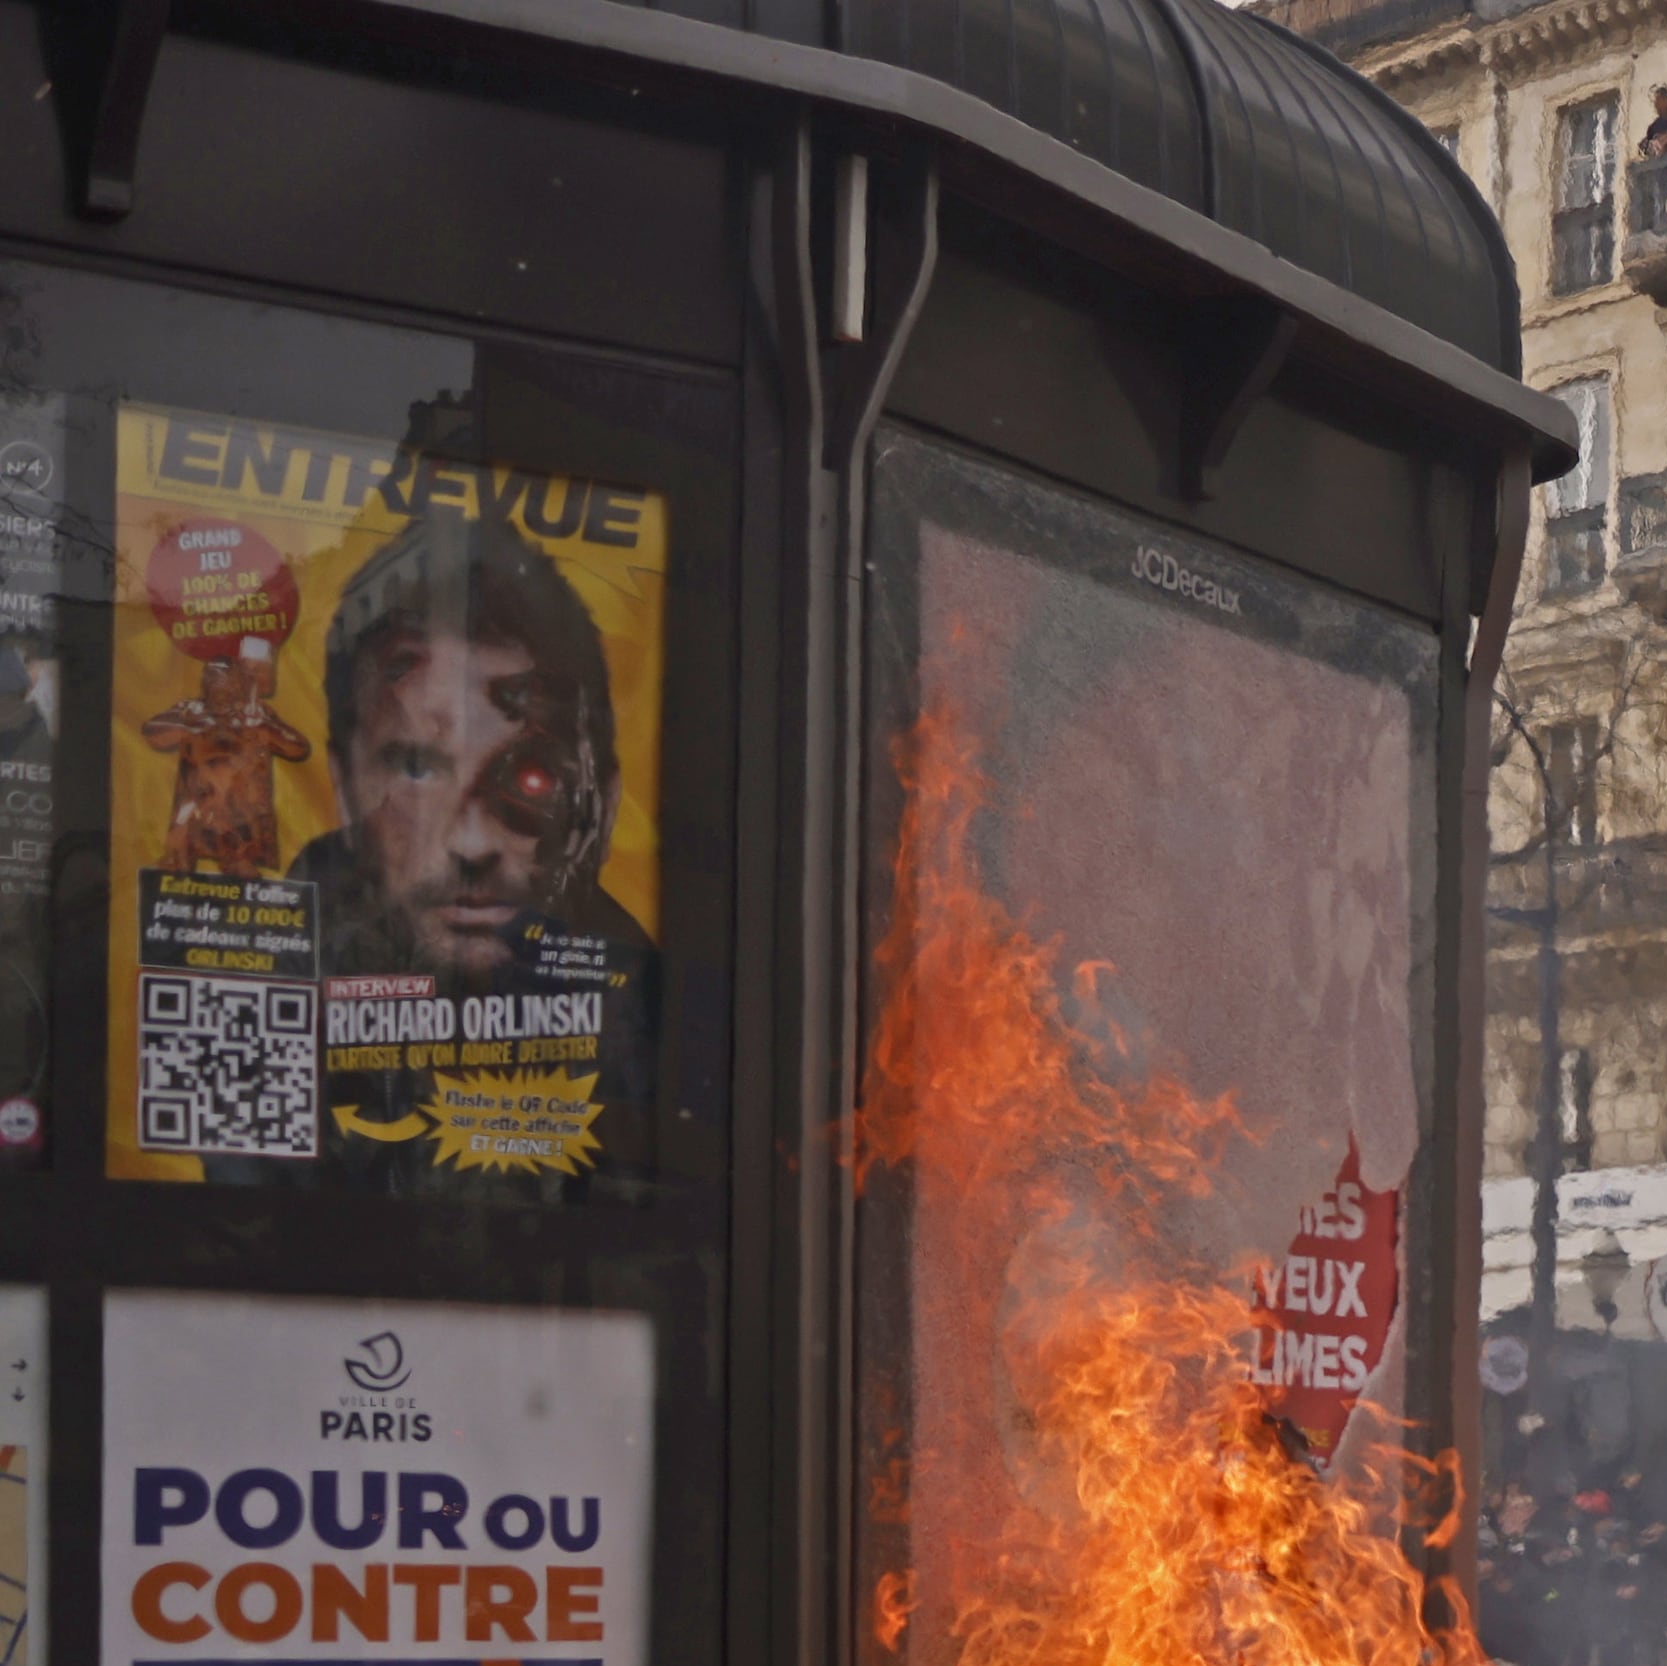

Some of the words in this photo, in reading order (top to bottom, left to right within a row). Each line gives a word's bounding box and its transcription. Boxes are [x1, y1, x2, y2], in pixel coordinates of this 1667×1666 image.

[159, 416, 646, 549] ENTREVUE
[178, 528, 242, 551] GRAND
[200, 551, 231, 571] JEU
[181, 573, 232, 595] 100%
[237, 571, 262, 589] DE
[1131, 545, 1243, 616] JCDecaux
[182, 592, 269, 616] CHANCES
[172, 621, 197, 639] DE
[203, 613, 276, 636] GAGNER
[160, 875, 240, 899] Entrevue
[154, 899, 192, 919] plus
[196, 902, 220, 921] de
[226, 905, 250, 924] 10
[146, 922, 170, 941] de
[174, 925, 250, 947] cadeaux
[186, 947, 275, 972] ORLINSKI
[330, 979, 431, 997] INTERVIEW
[327, 997, 455, 1044] RICHARD
[462, 992, 602, 1041] ORLINSKI
[451, 1115, 476, 1129] sur
[481, 1116, 520, 1132] cette
[471, 1134, 491, 1151] ET
[339, 1394, 388, 1408] VILLE
[395, 1396, 416, 1409] DE
[320, 1410, 433, 1442] PARIS
[133, 1465, 470, 1551] POUR
[483, 1493, 600, 1553] OU
[131, 1561, 604, 1644] CONTRE
